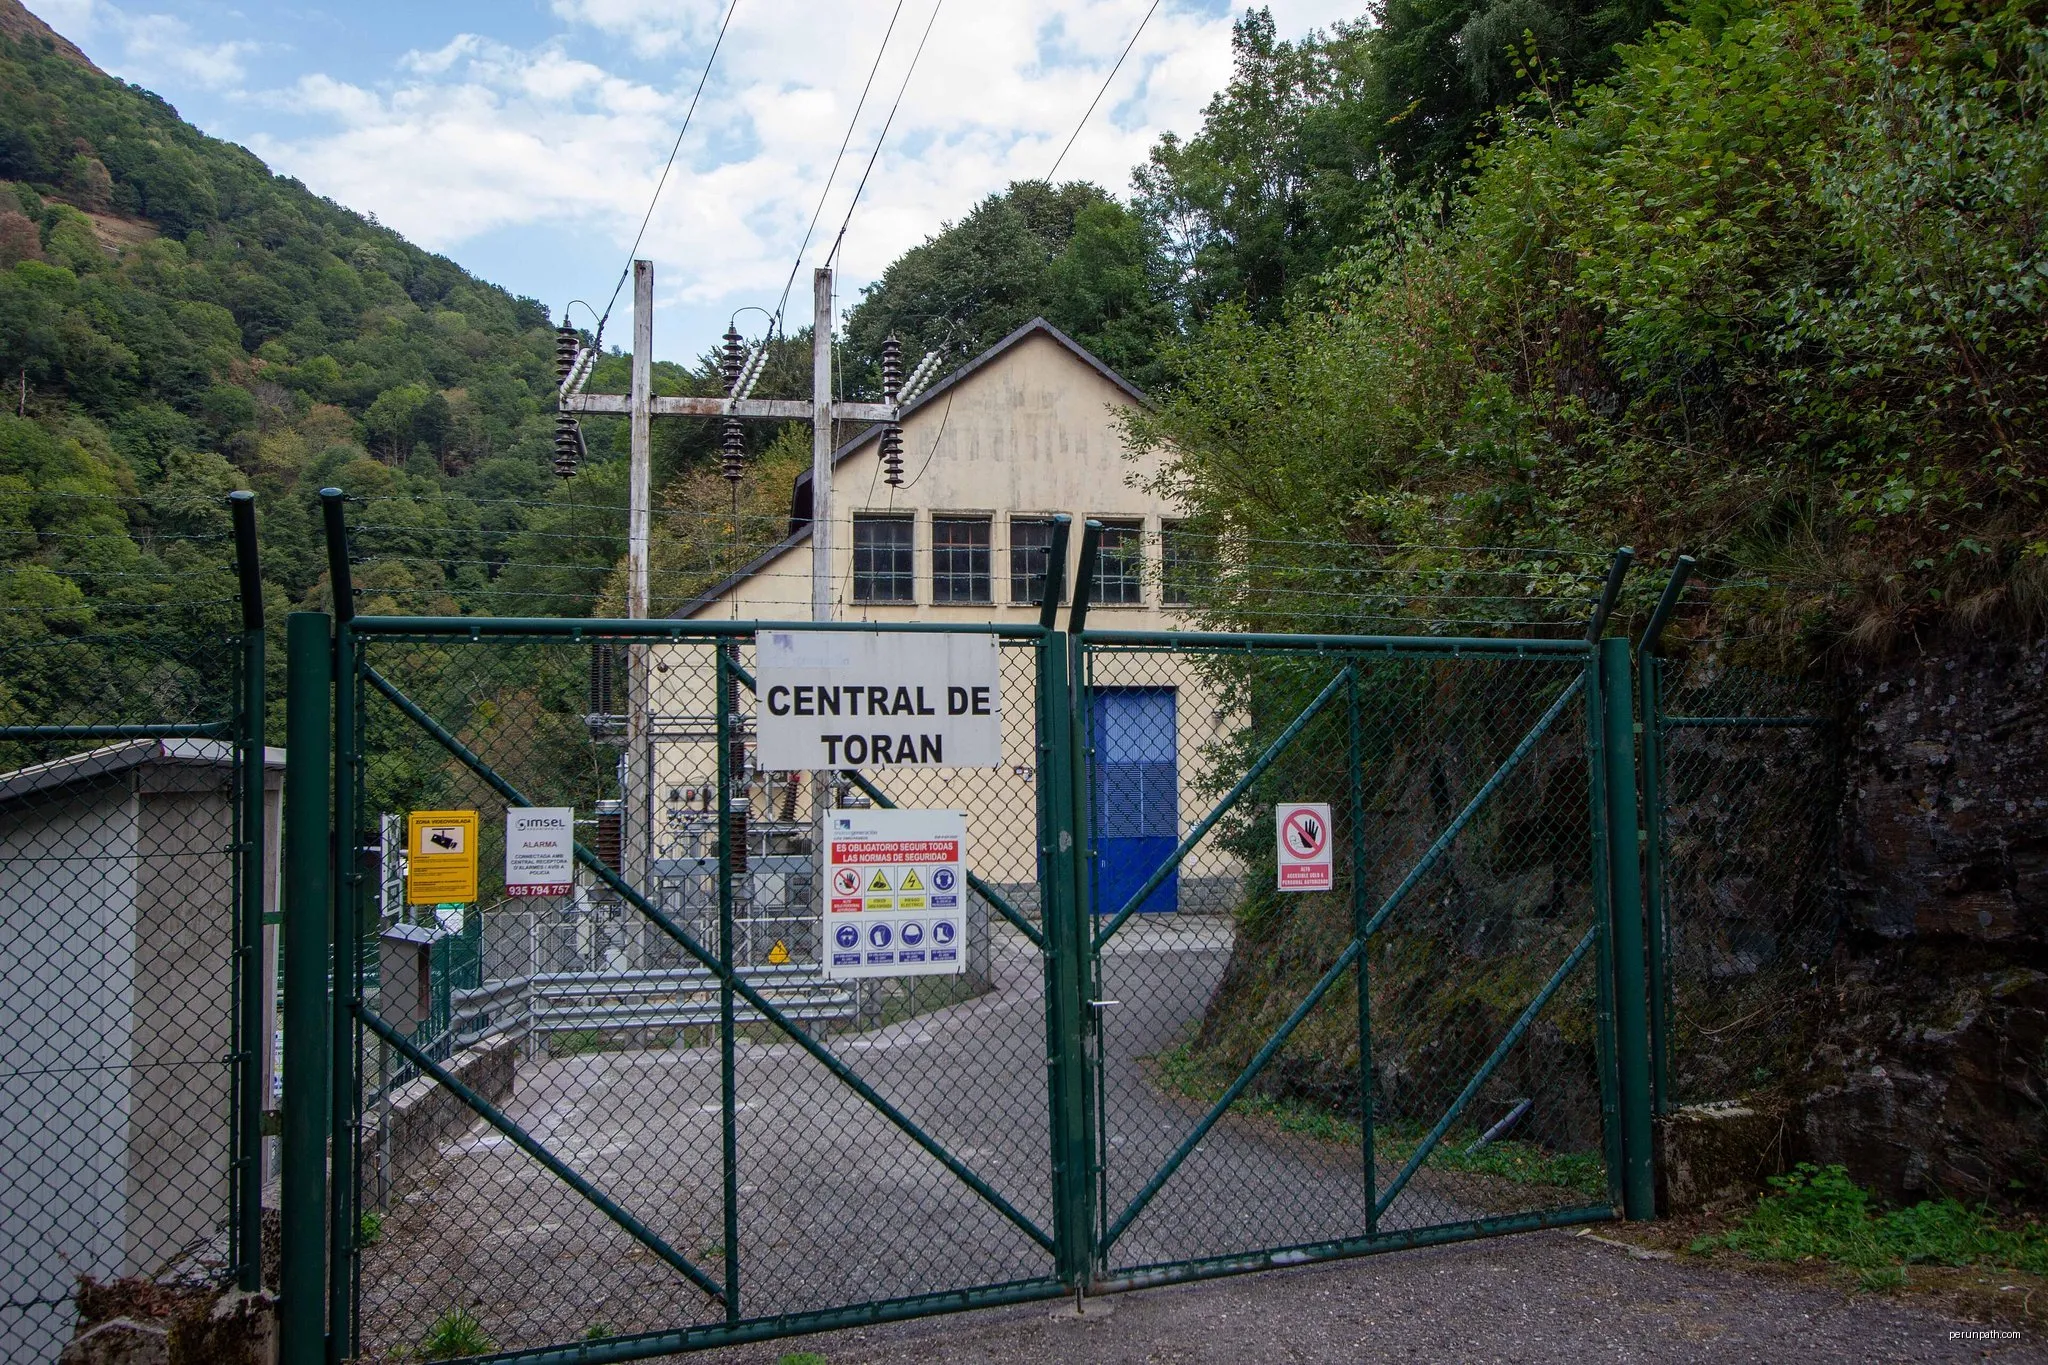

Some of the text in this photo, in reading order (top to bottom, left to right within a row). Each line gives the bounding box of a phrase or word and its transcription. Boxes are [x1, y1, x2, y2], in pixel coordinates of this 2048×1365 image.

[767, 685, 990, 716] CENTRAL DE
[821, 734, 942, 765] TORAN
[836, 842, 953, 852] ES OBLIGATORIO SEGUIR TODAS
[843, 852, 947, 863] LAS NORMAS DE SEGURIDAD
[508, 885, 570, 895] 935 794 757
